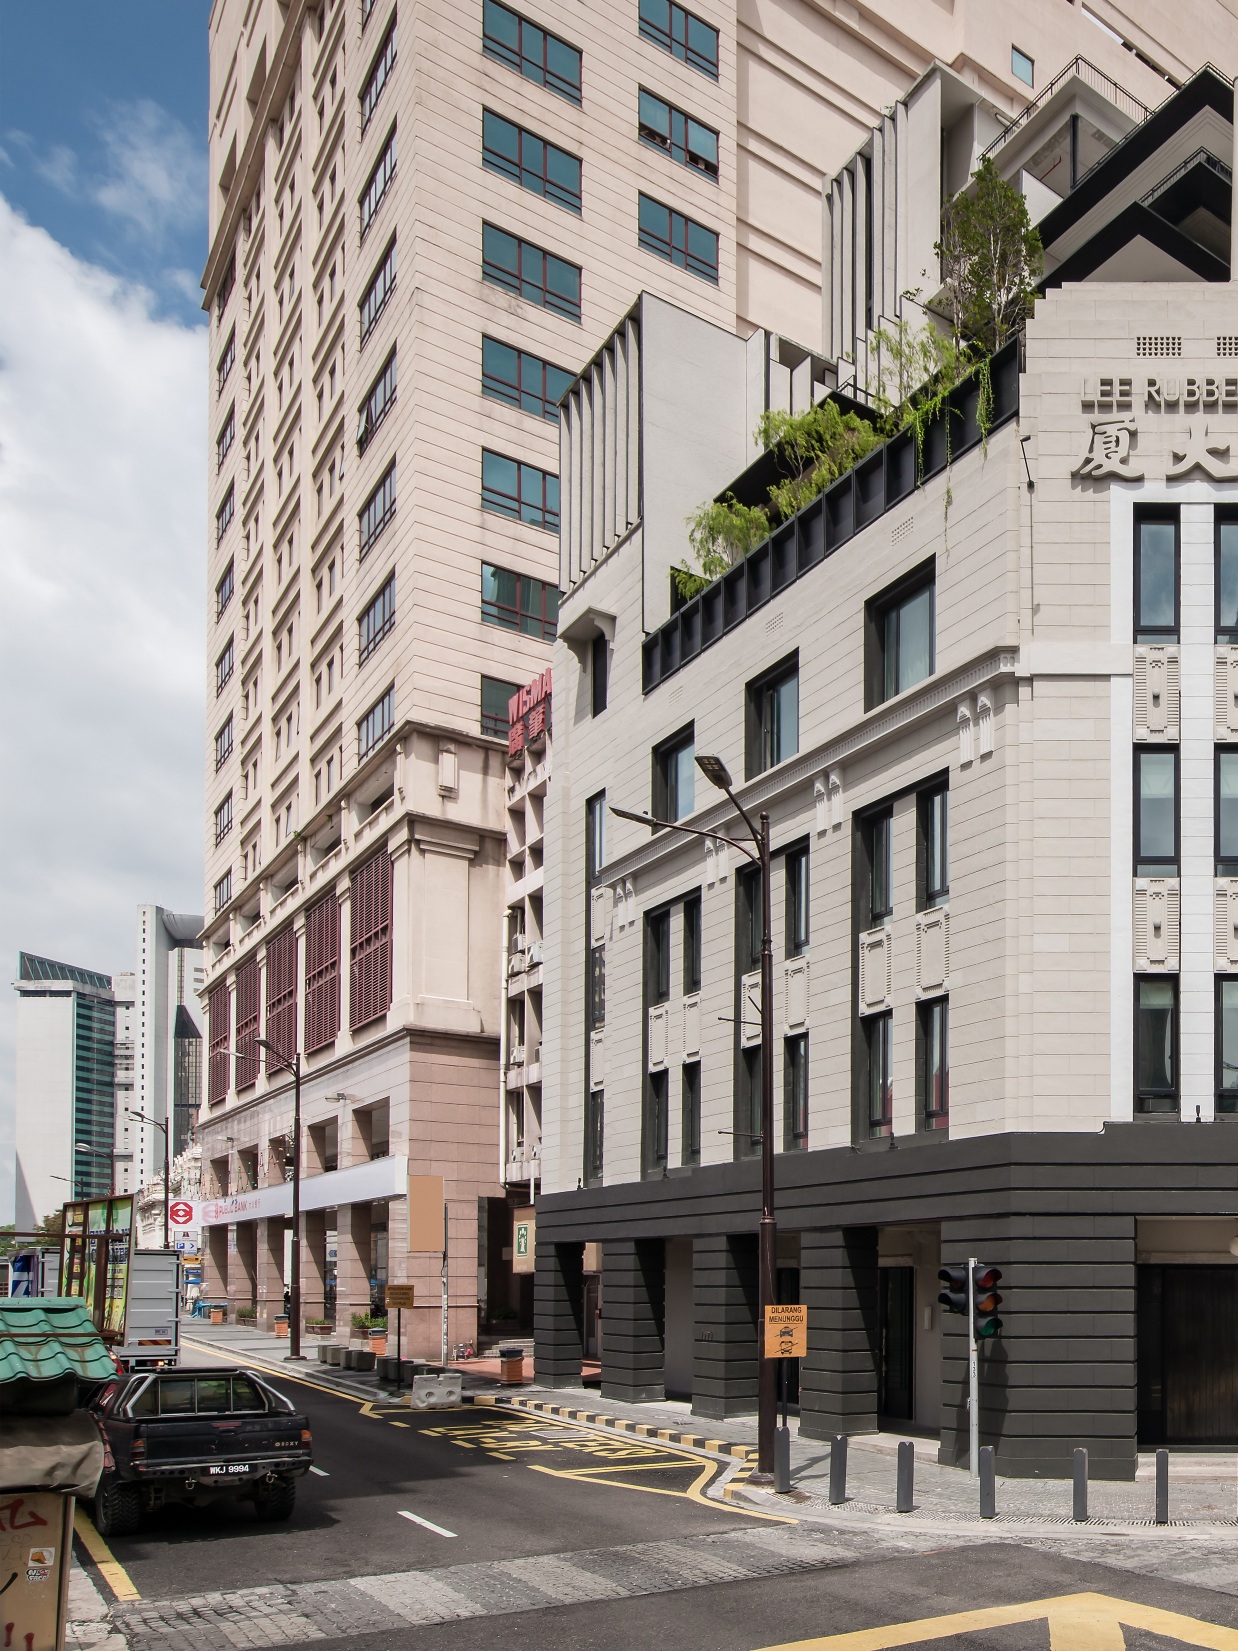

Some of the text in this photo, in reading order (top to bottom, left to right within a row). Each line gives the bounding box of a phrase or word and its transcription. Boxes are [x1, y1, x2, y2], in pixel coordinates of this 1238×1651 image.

[1081, 377, 1133, 404] LEE
[508, 667, 552, 725] WISMA
[771, 1306, 802, 1314] DILARANG
[481, 1419, 564, 1431] BAS
[546, 1435, 668, 1459] TEKSI
[209, 1464, 250, 1475] WKJ 9994
